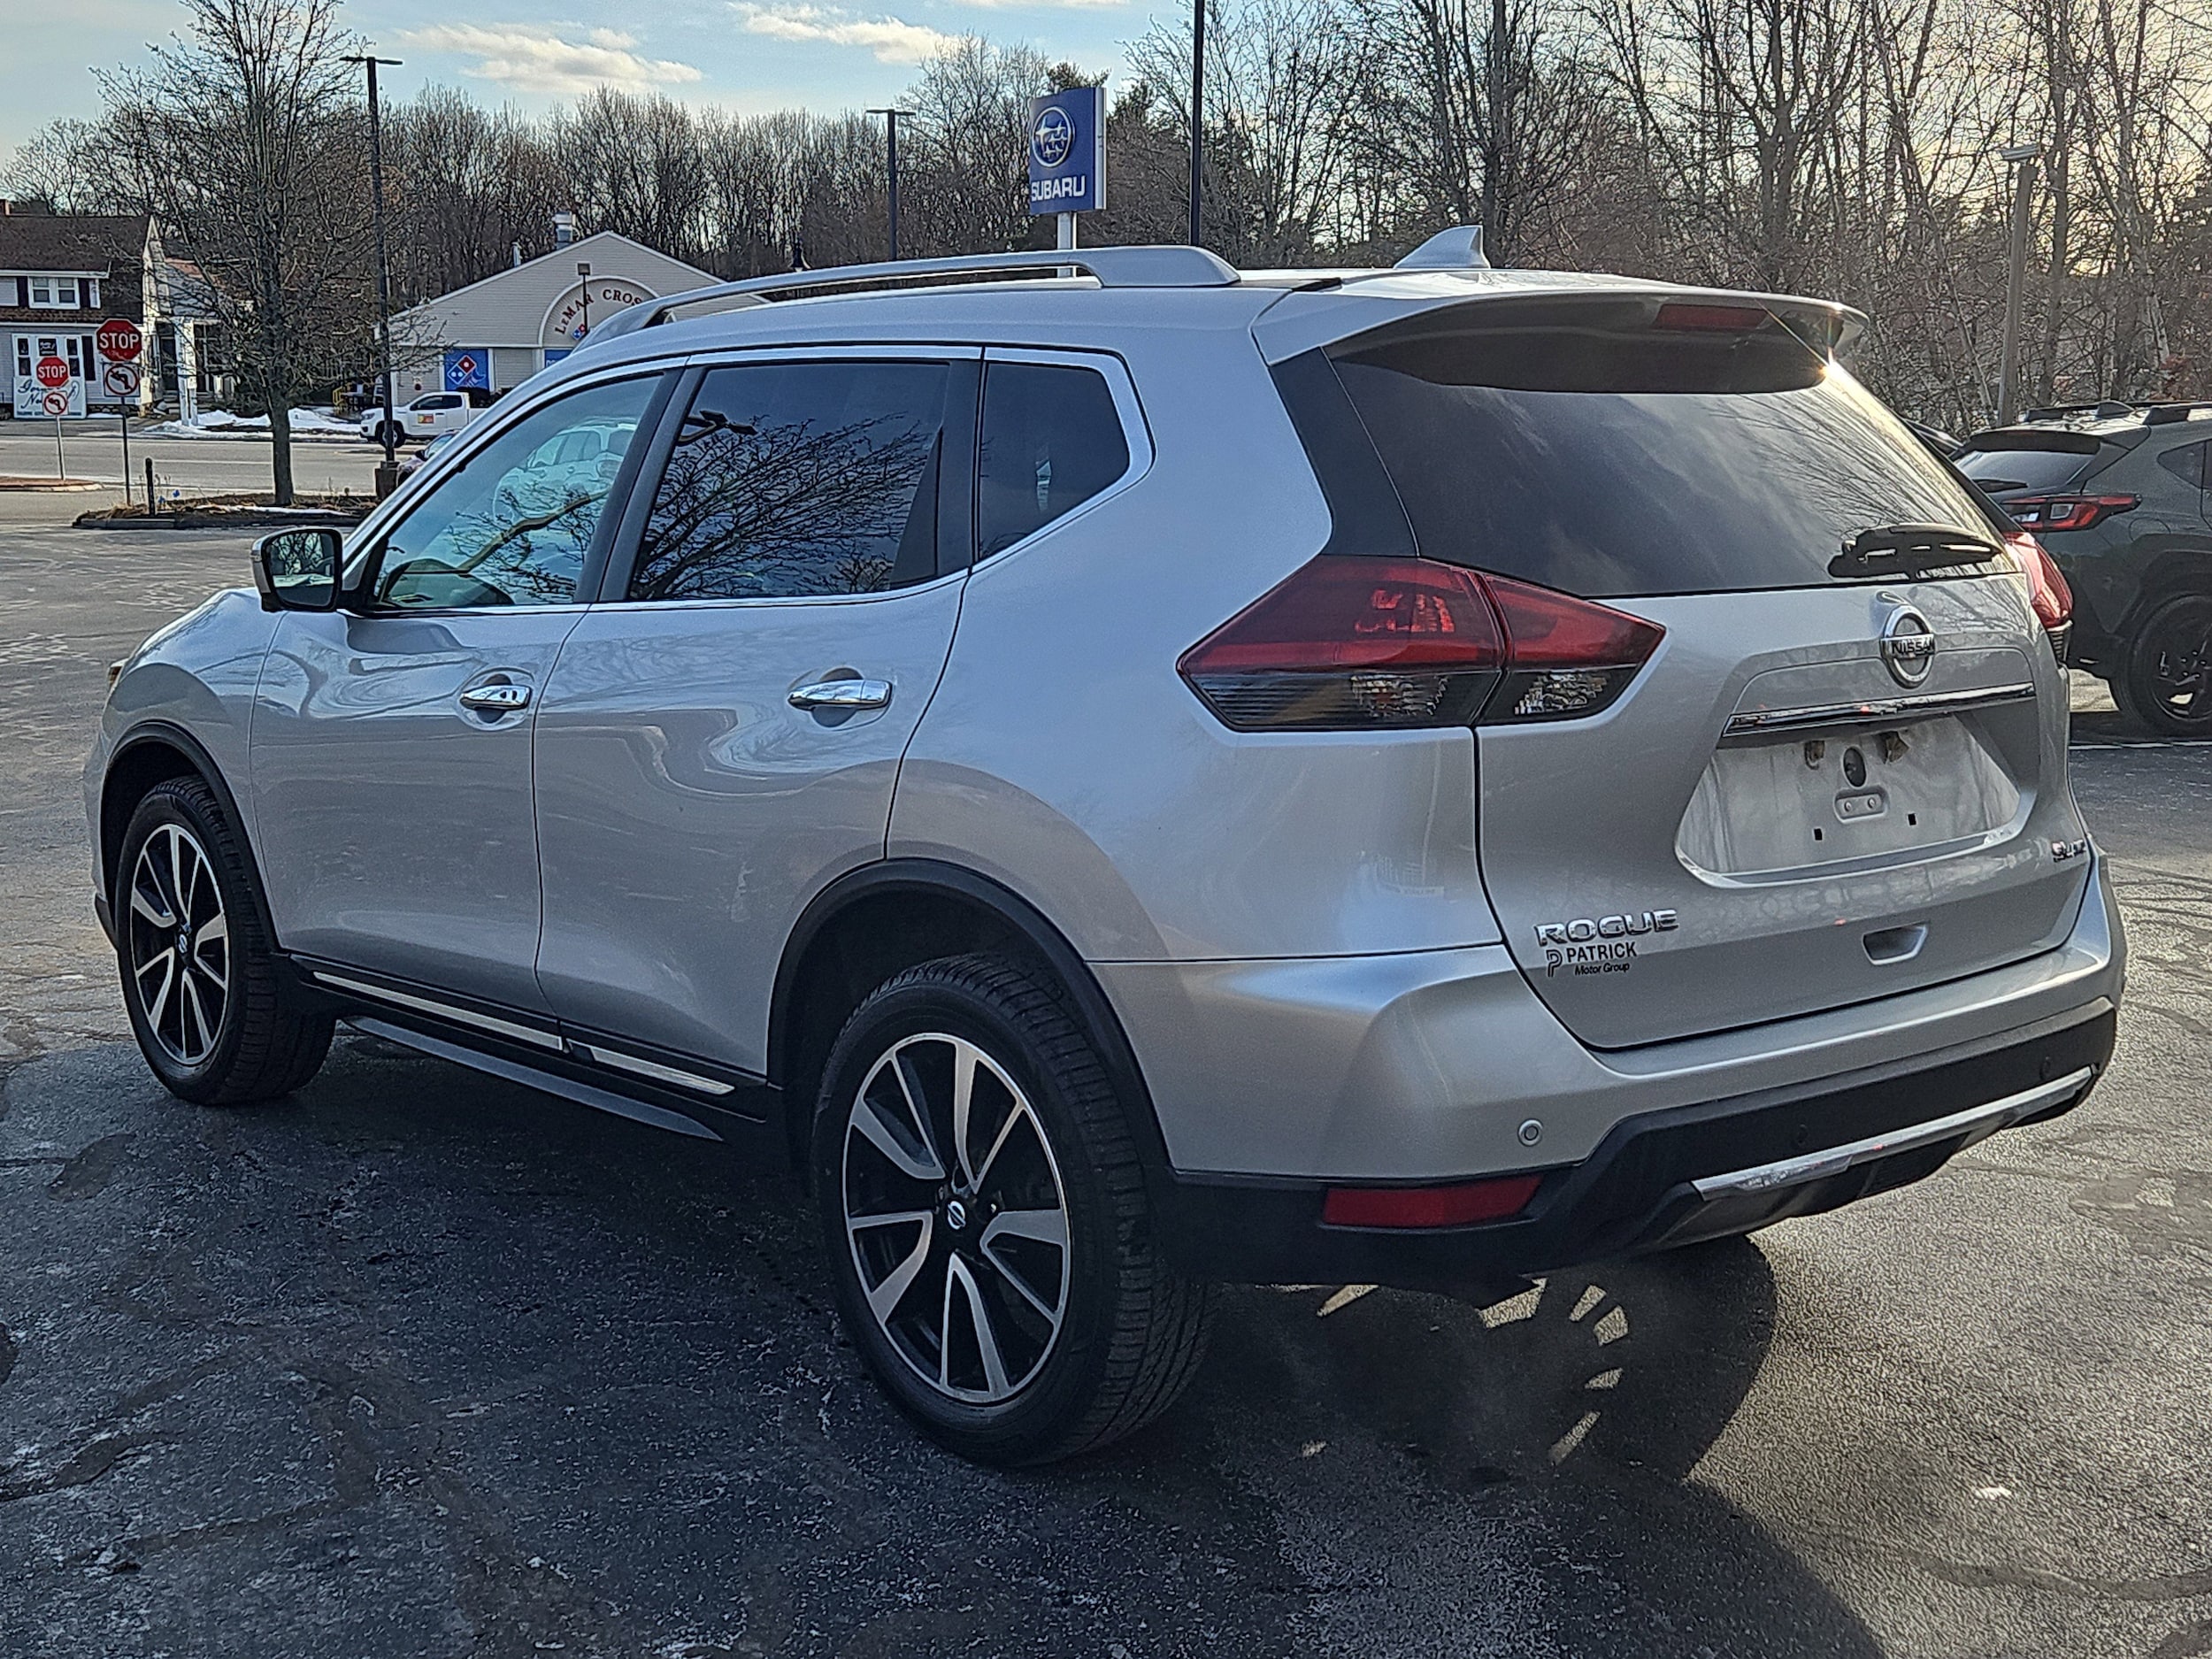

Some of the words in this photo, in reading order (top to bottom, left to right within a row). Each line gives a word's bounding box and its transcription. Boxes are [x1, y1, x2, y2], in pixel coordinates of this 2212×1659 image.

[1031, 175, 1086, 202] SUBARU
[99, 332, 139, 349] STOP
[38, 365, 66, 379] STOP
[1892, 640, 1935, 655] NISSAN
[1533, 909, 1679, 947] ROGUE
[1566, 941, 1638, 964] PATRICK
[1575, 964, 1602, 976] Motor
[1603, 962, 1630, 973] Group
